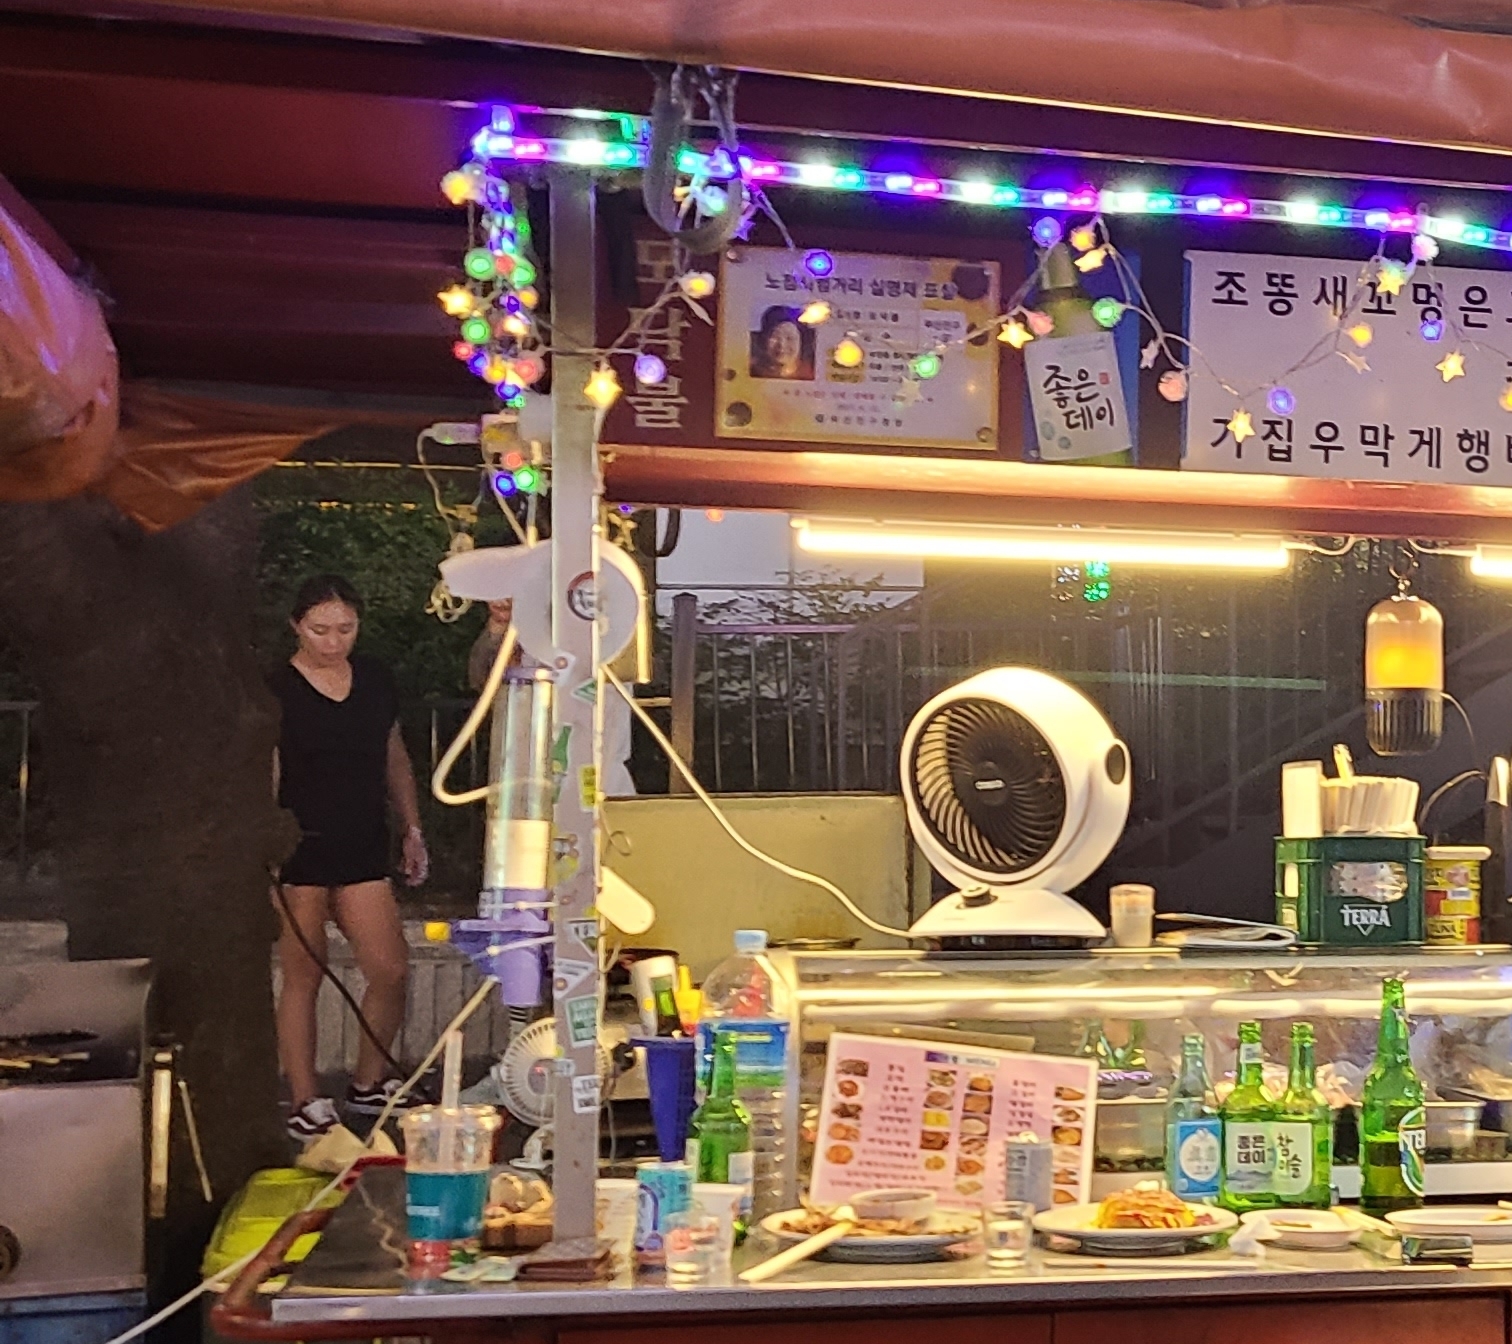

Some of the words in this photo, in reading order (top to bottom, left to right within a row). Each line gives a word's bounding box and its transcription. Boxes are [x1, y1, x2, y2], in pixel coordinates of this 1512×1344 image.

[1043, 364, 1100, 410] 좋은
[1062, 397, 1115, 431] 데이
[1339, 904, 1391, 927] TERRA
